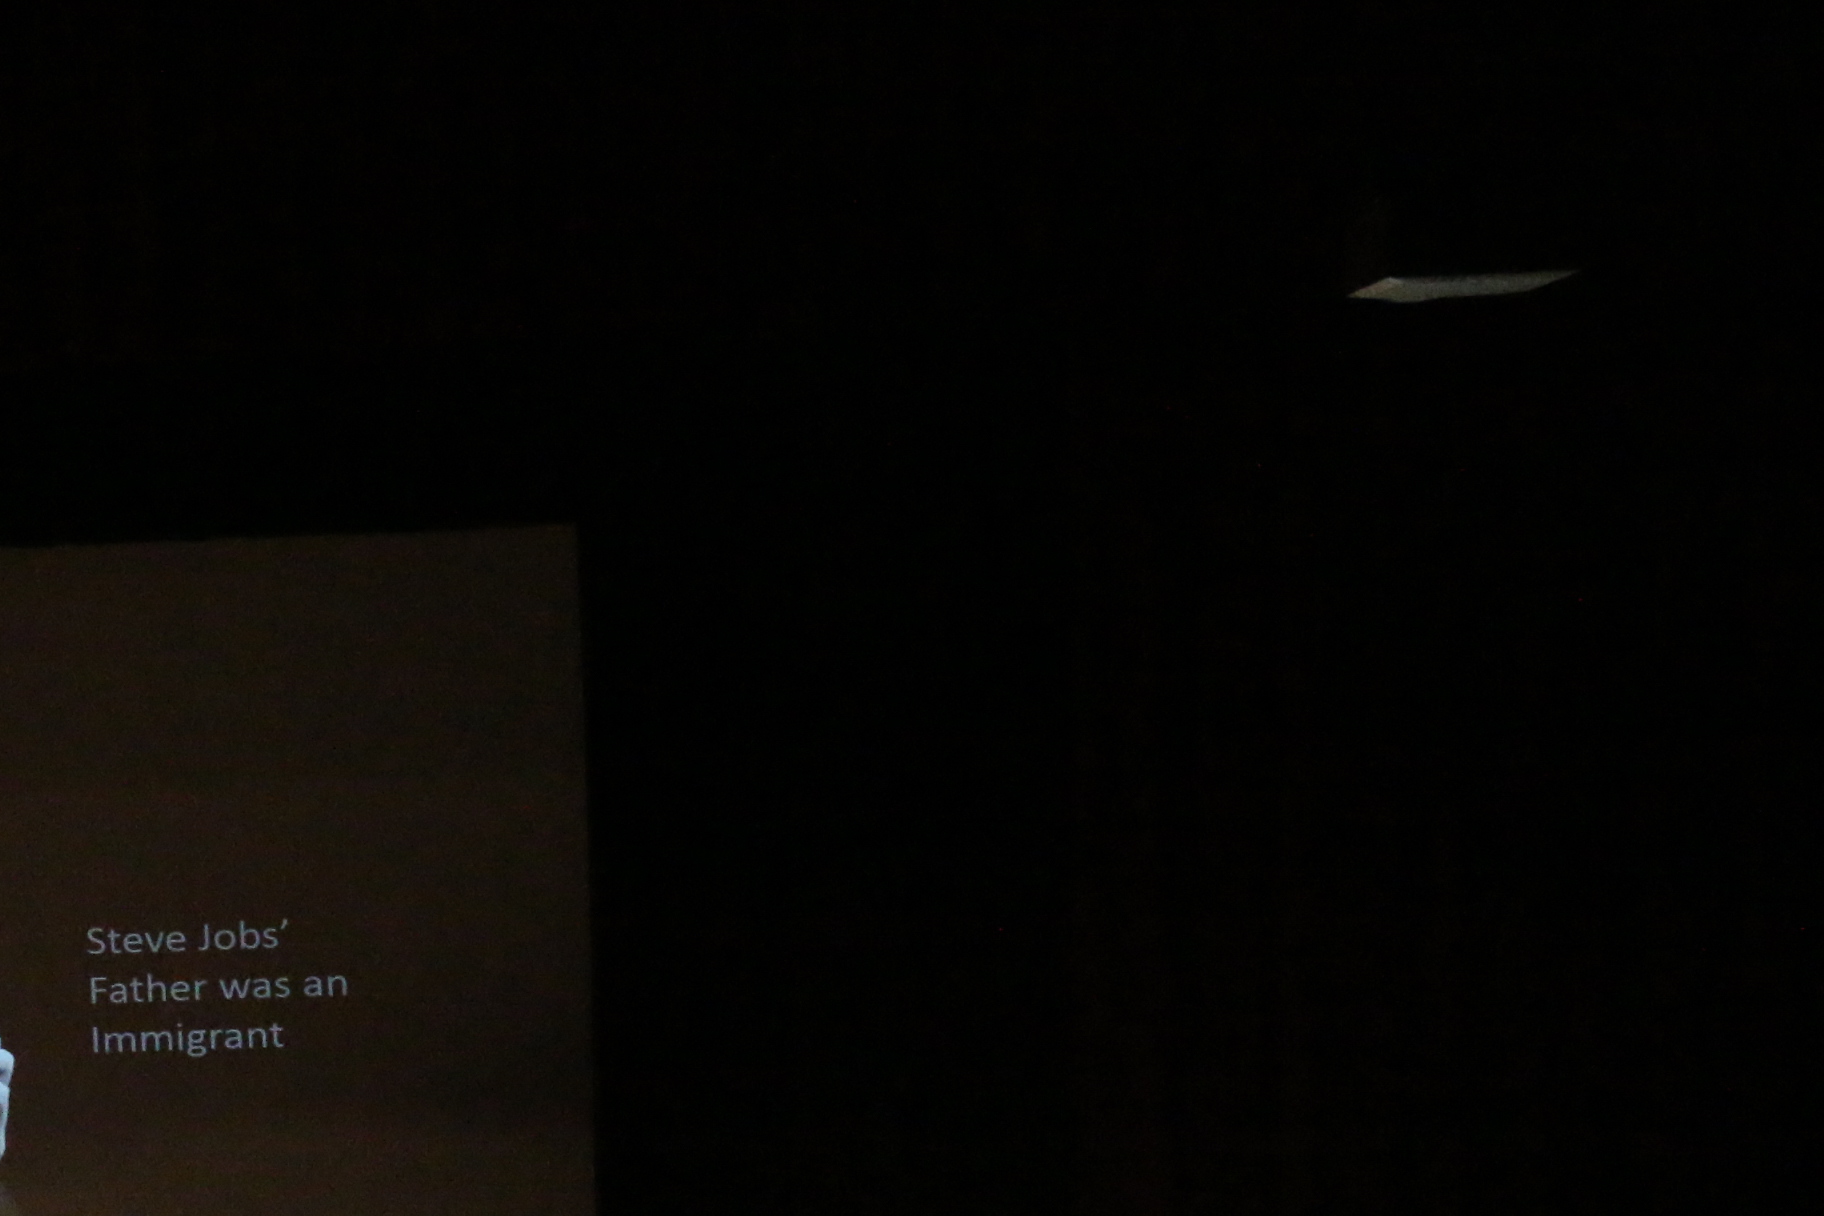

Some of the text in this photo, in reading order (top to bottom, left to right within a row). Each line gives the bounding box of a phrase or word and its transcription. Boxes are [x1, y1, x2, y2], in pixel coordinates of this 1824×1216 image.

[86, 927, 187, 955] Steve
[90, 973, 349, 1005] Father was an
[92, 1022, 285, 1058] Immigrant
